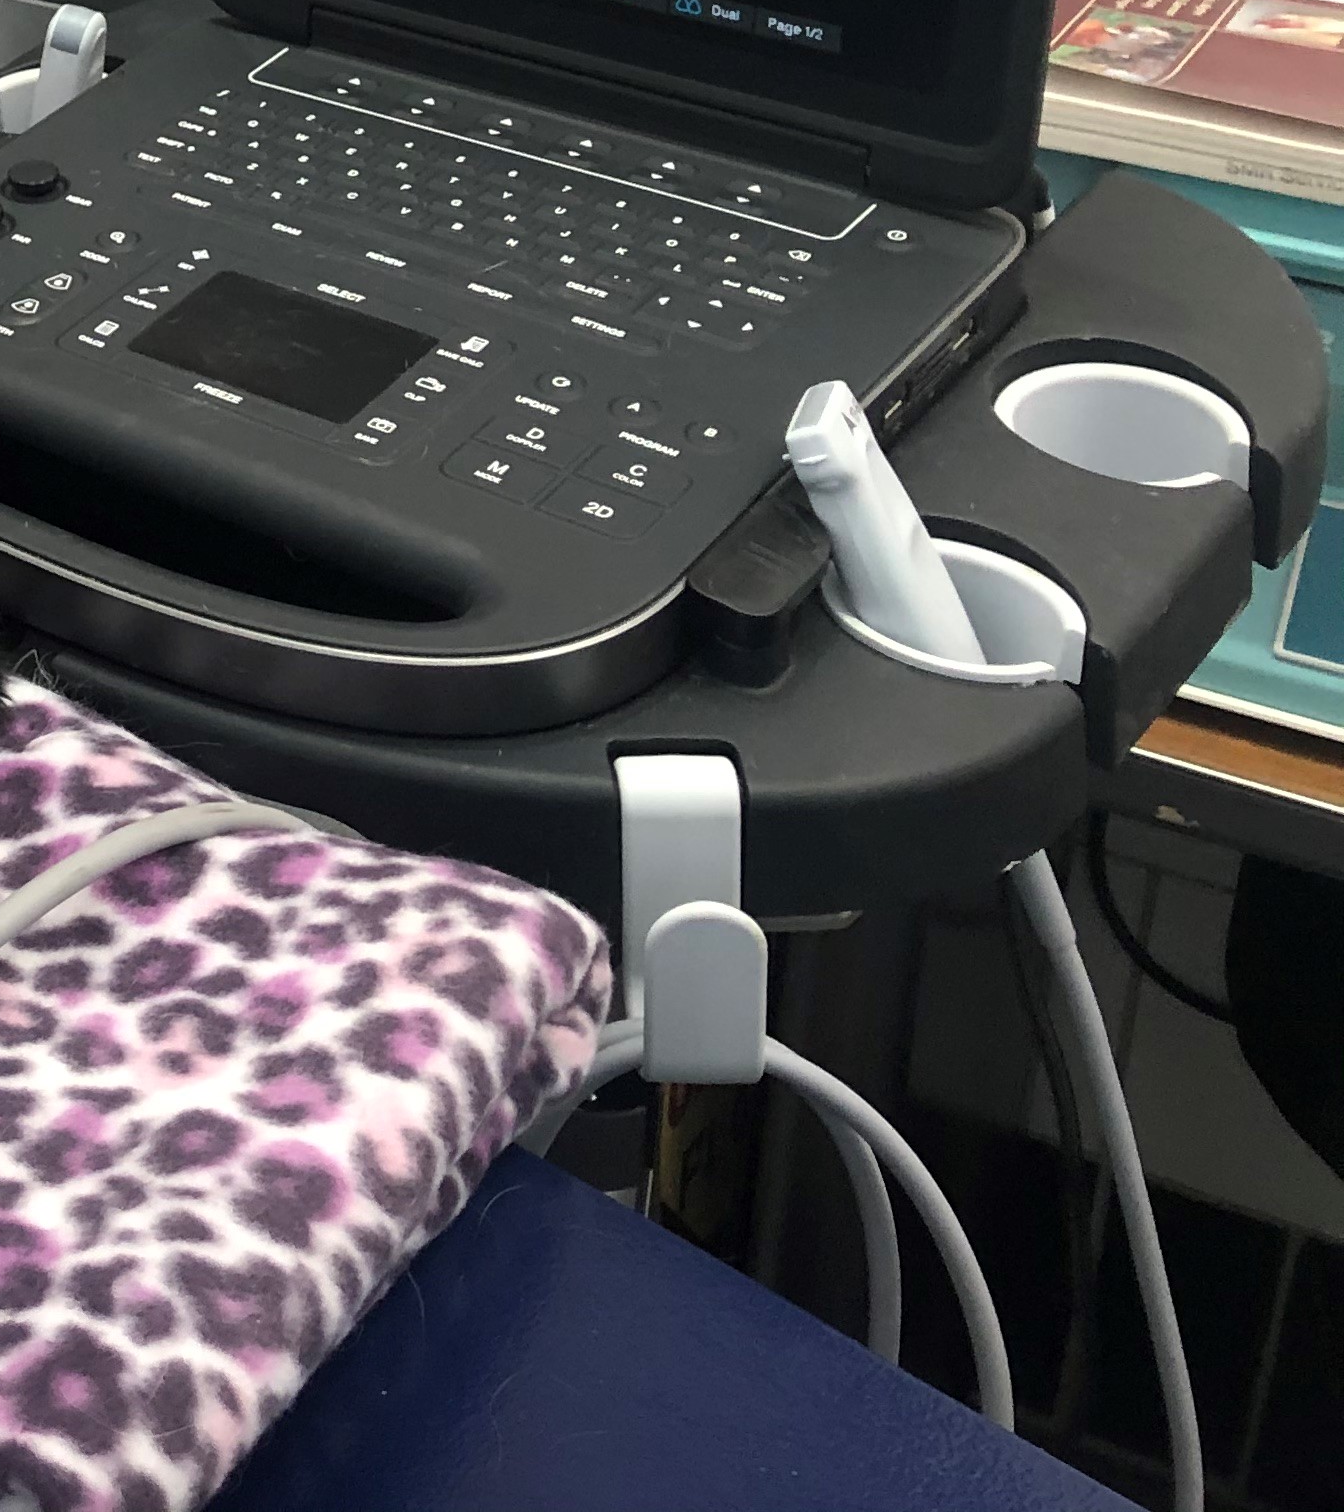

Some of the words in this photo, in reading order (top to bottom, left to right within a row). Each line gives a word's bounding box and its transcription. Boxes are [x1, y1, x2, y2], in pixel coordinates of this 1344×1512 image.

[711, 3, 741, 22] Dual
[767, 16, 803, 37] Page
[805, 26, 824, 41] 1/2
[79, 249, 111, 264] ZOOM
[365, 250, 407, 268] REVIEW
[316, 283, 367, 303] SELECT
[466, 281, 513, 301] REPORT
[565, 280, 609, 299] DELETE
[746, 285, 787, 303] ENTER
[570, 314, 627, 338] SETTINGS
[192, 382, 244, 405] FREEZE
[514, 394, 561, 416] UPDATE
[626, 401, 642, 413] A
[525, 426, 546, 440] D
[505, 433, 548, 453] DOPPLER
[618, 430, 681, 458] PROGRAM
[473, 469, 503, 485] MODE
[486, 459, 511, 476] M
[627, 463, 649, 478] C
[611, 472, 646, 488] COLOR
[581, 500, 616, 520] 2D
